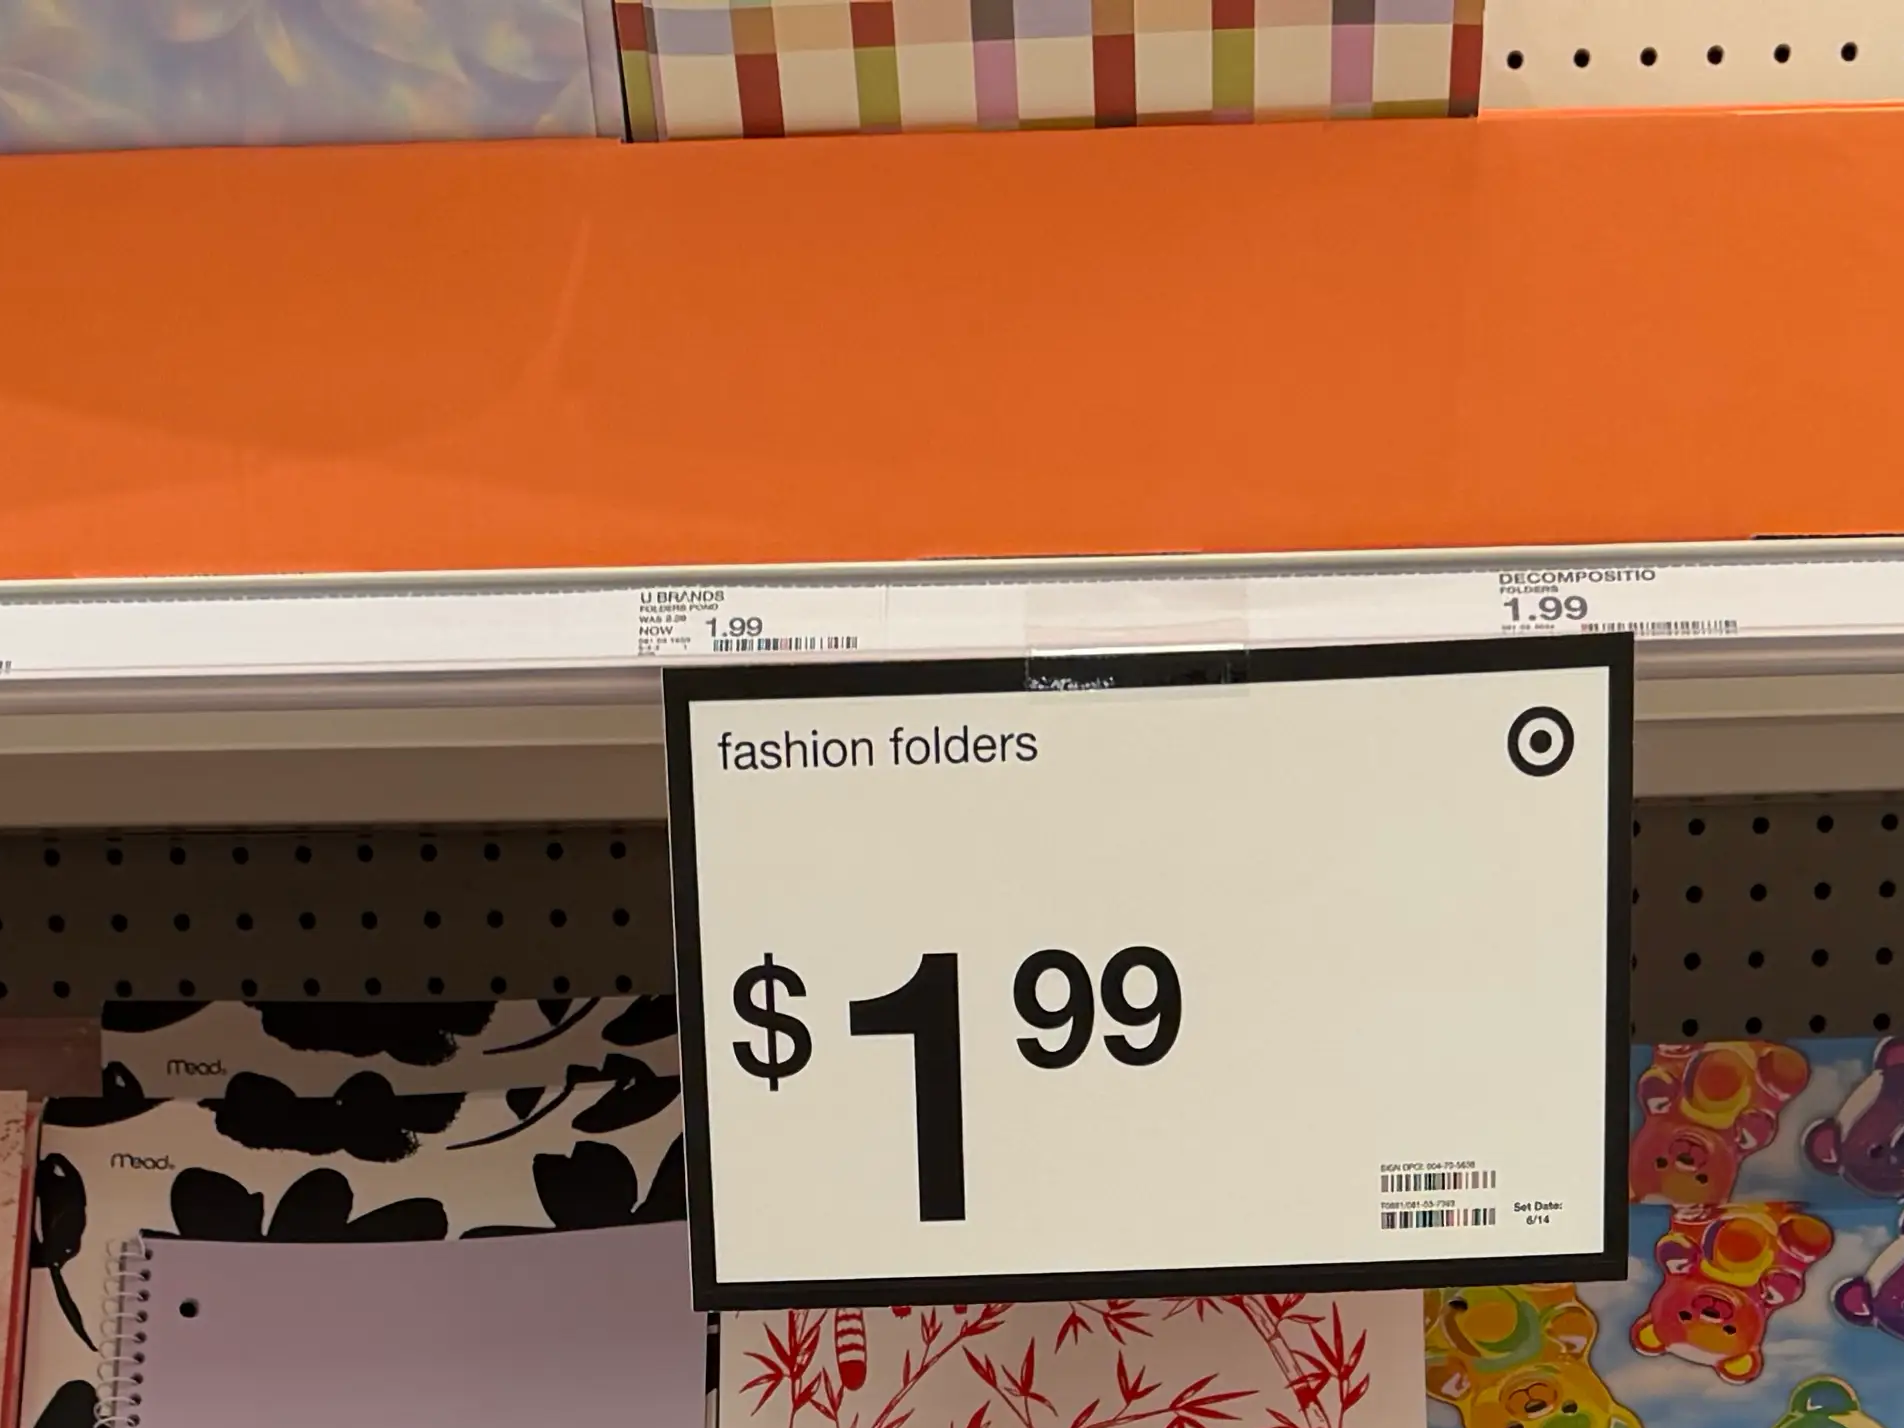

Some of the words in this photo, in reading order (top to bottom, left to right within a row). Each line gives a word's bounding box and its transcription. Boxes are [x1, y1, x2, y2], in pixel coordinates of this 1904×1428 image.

[1499, 568, 1656, 585] DECOMPOSITIO
[640, 592, 652, 604] U
[656, 591, 725, 603] BRANDS
[1503, 596, 1588, 621] 1.99
[639, 625, 674, 636] NOW
[705, 617, 763, 638] 1.99
[718, 728, 875, 771] fashion
[890, 724, 1039, 767] folders
